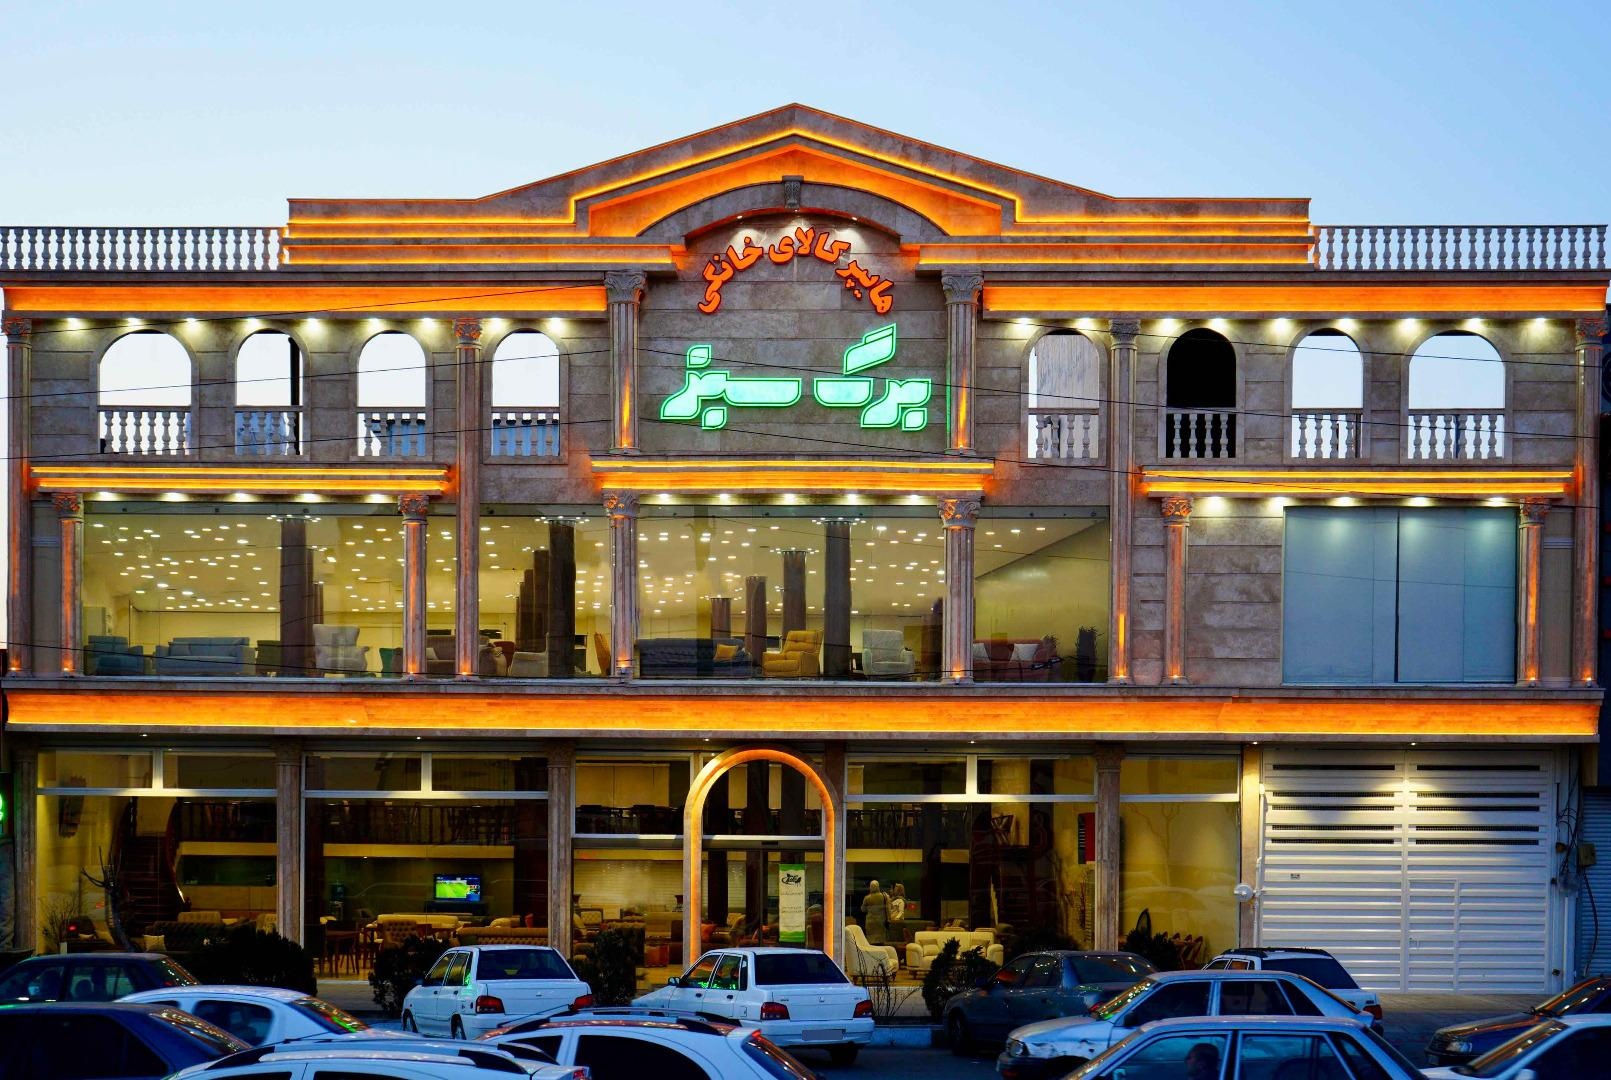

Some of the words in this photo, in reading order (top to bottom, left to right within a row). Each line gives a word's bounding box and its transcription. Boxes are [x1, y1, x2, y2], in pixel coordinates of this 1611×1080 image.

[697, 237, 763, 314] خانگی
[768, 227, 851, 264] کالای
[835, 260, 894, 314] هایپر
[660, 345, 802, 430] سبز
[813, 323, 931, 430] برگ
